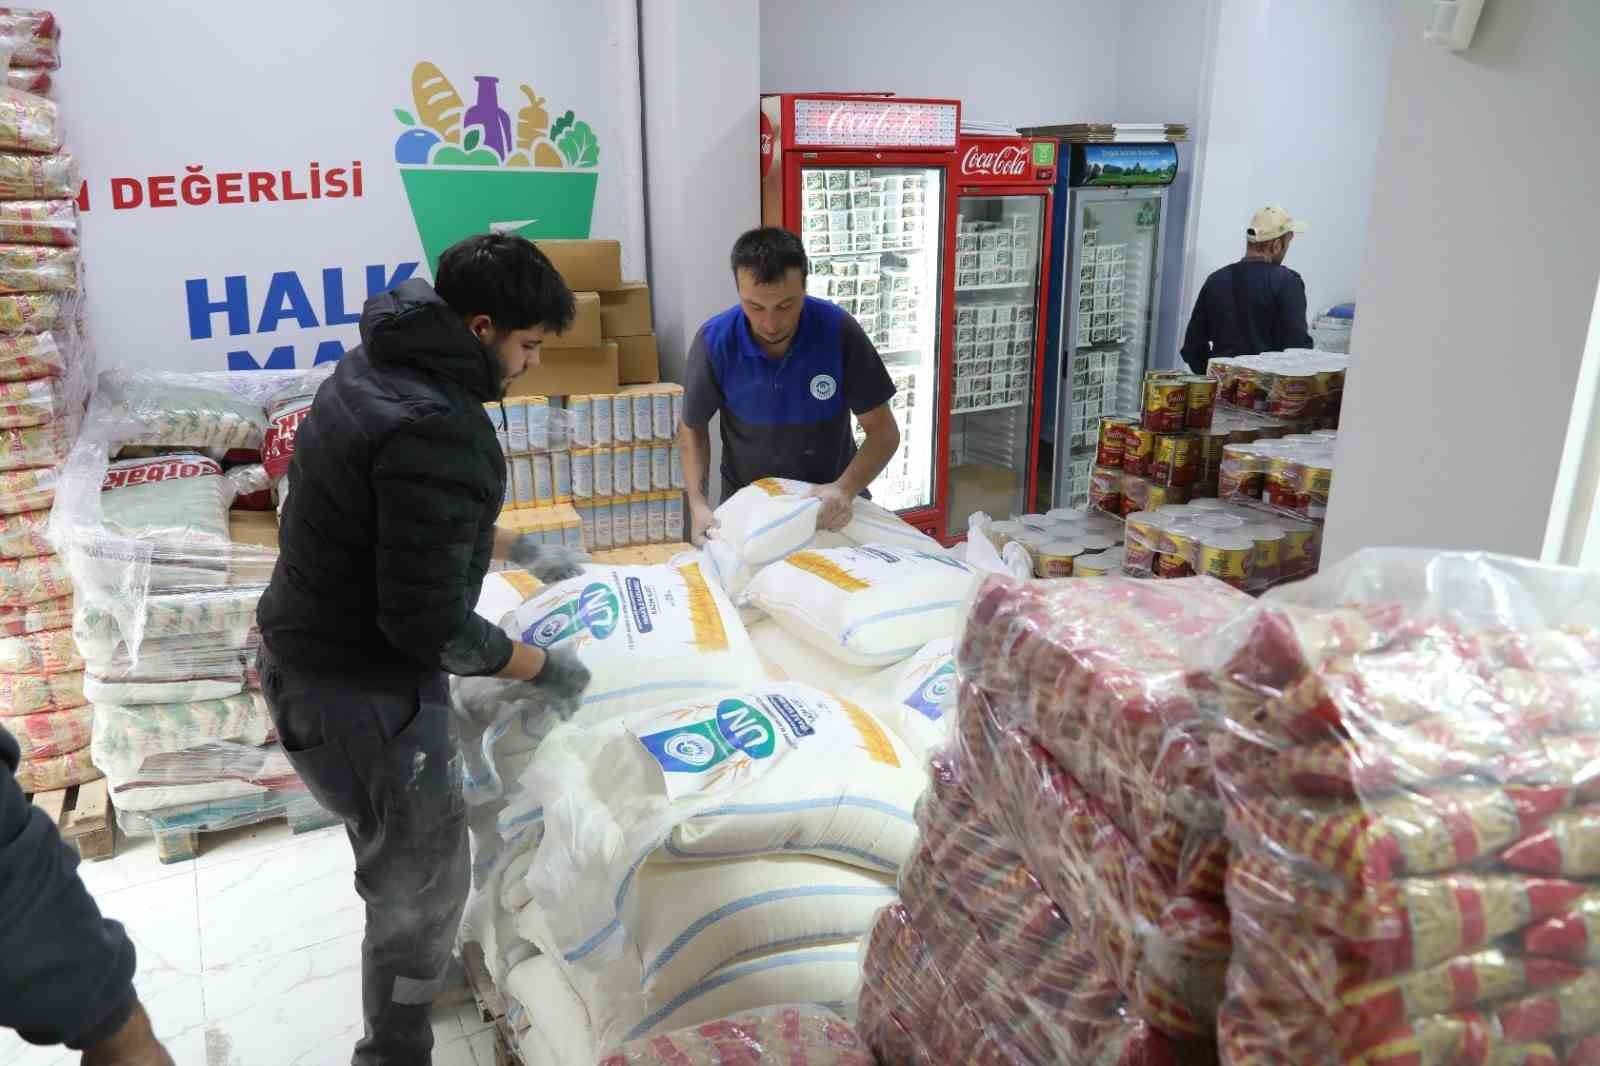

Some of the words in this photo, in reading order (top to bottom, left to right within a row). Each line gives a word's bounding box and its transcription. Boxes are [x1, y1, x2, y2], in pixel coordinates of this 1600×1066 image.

[111, 160, 363, 210] DEĞERLİSİ
[583, 588, 613, 626] UN
[721, 707, 768, 747] UN
